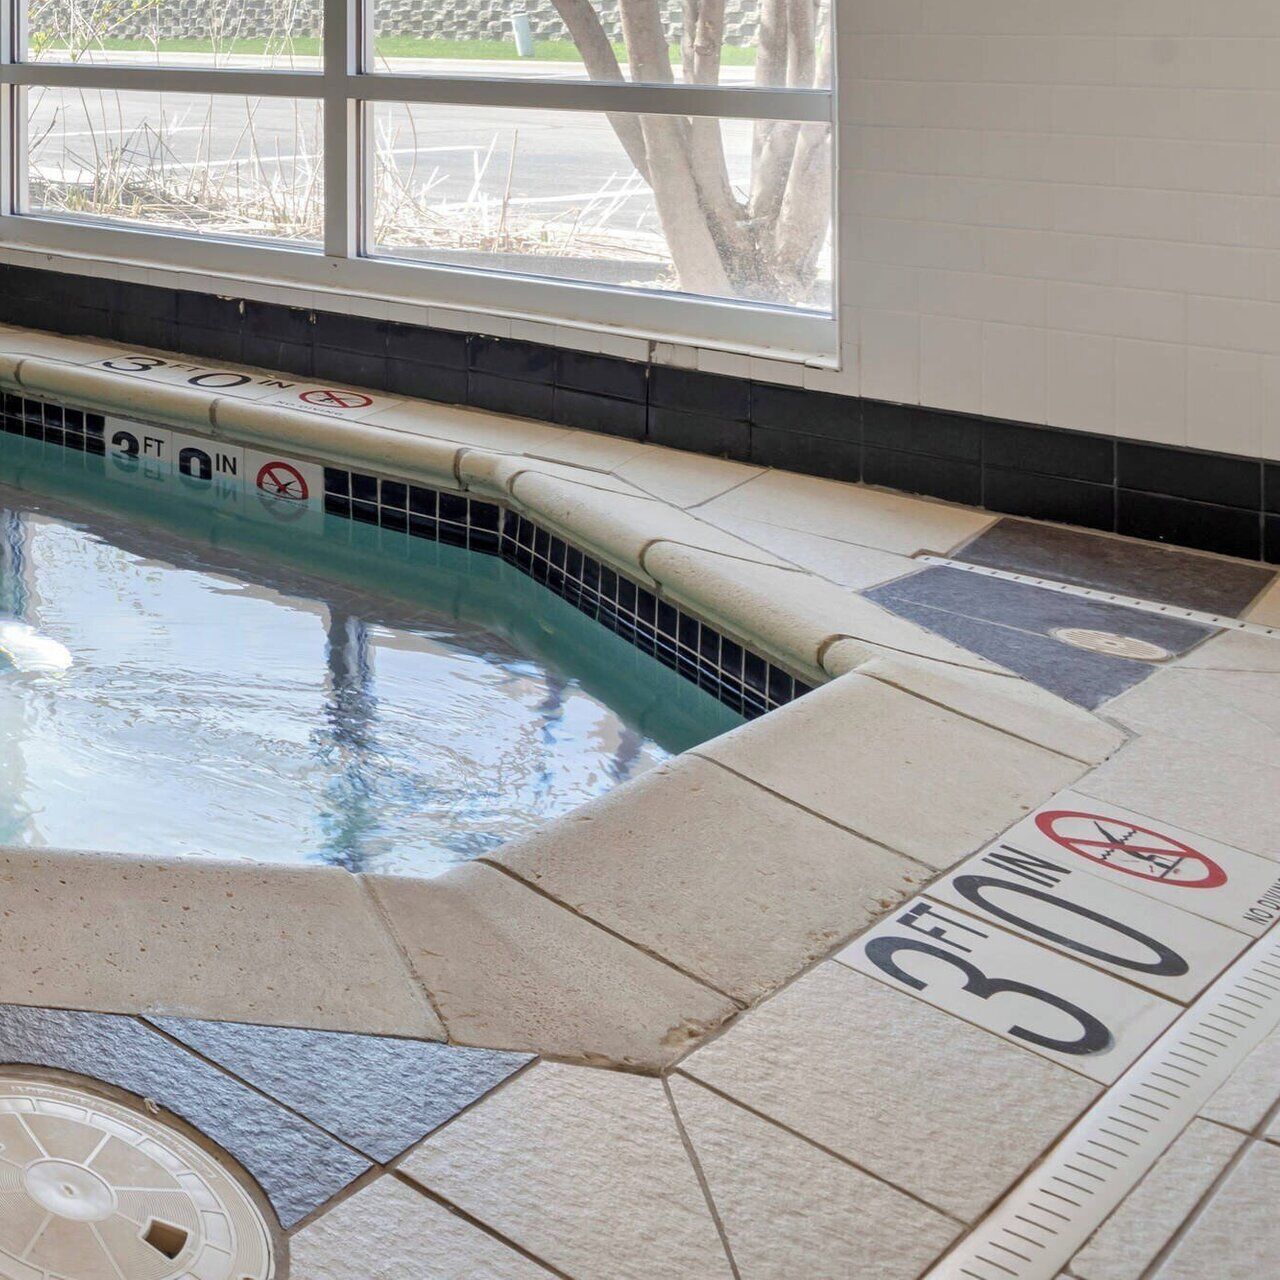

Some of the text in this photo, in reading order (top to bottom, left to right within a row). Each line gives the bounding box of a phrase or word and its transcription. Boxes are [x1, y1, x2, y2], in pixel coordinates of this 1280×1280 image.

[102, 356, 167, 372] 3
[187, 372, 252, 388] 0
[257, 379, 295, 389] IN
[143, 436, 165, 458] FT
[215, 452, 237, 476] IN
[1242, 907, 1275, 926] NO
[864, 844, 1190, 1056] 3 FT 0 IN
